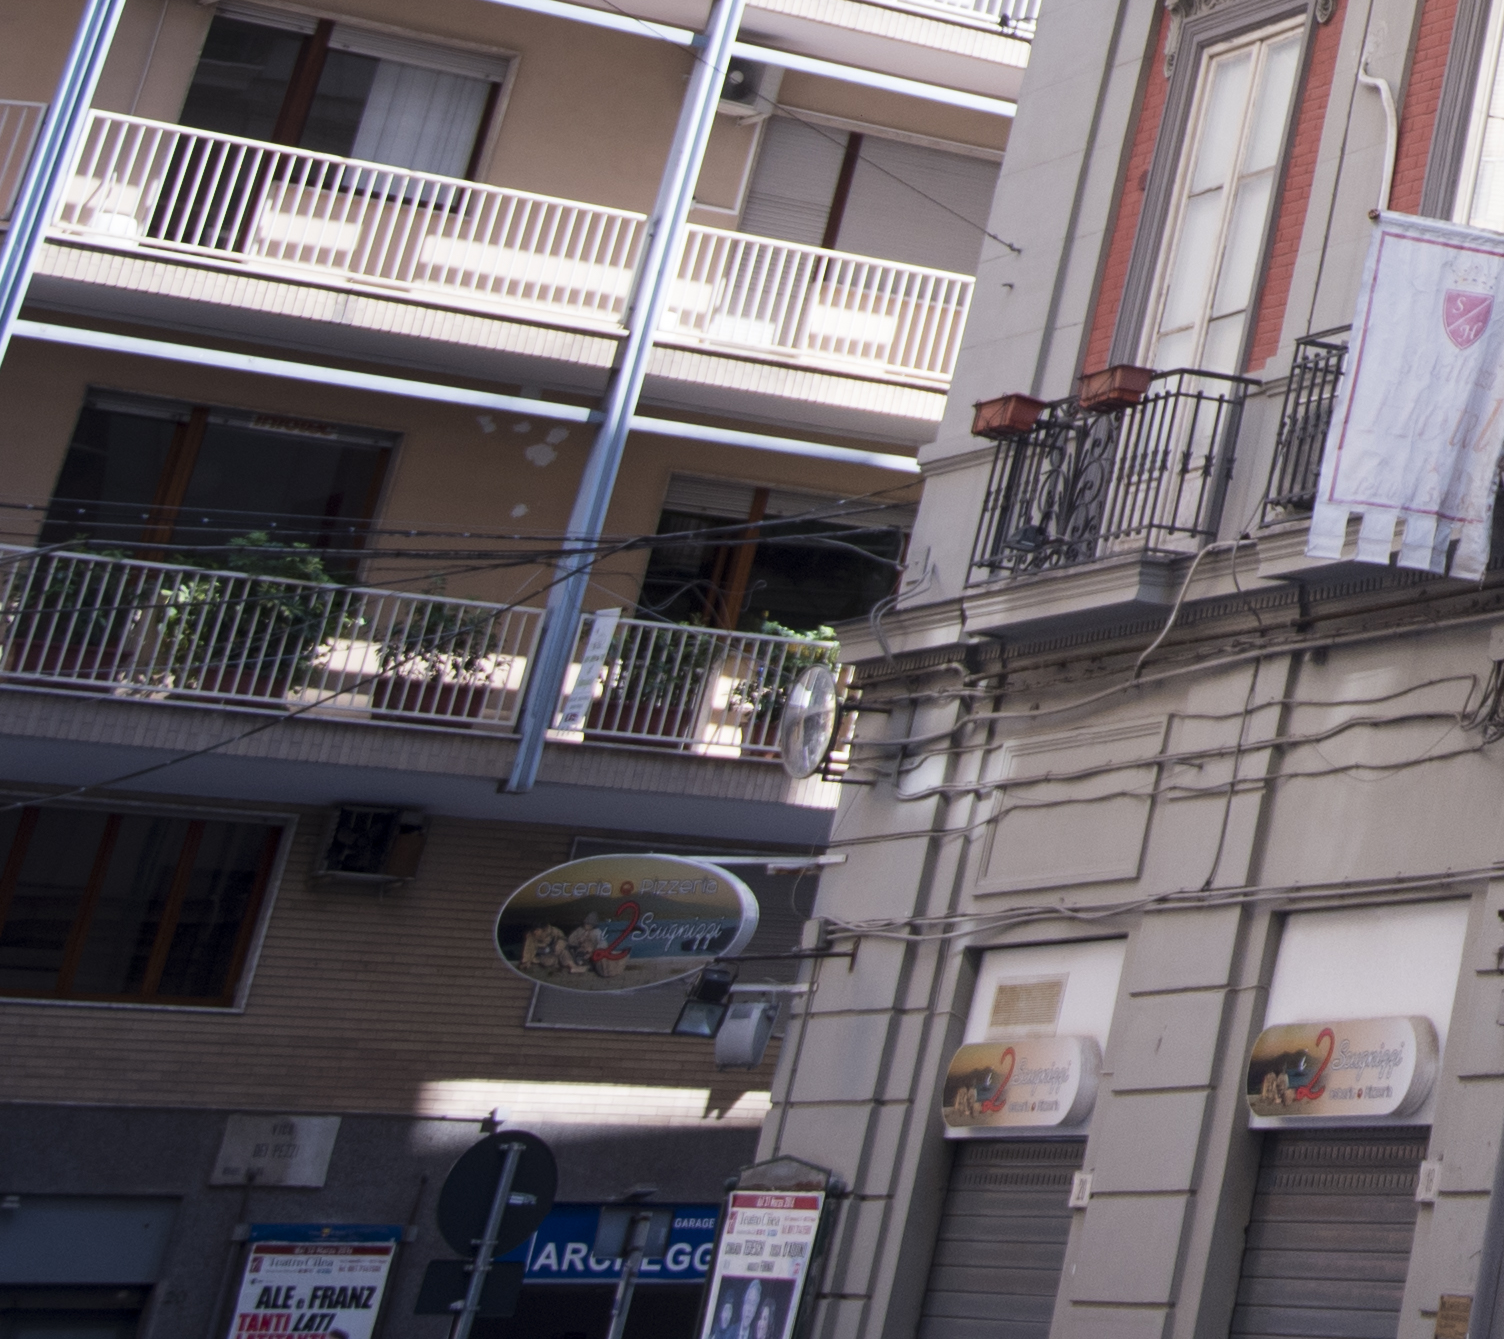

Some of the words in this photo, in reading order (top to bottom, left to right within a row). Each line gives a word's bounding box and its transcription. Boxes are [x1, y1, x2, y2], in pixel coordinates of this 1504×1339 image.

[1453, 297, 1465, 313] S
[536, 880, 612, 898] Osteria
[640, 877, 718, 896] Pizzeria
[592, 900, 641, 962] 2
[631, 912, 726, 952] Scugnizzi
[1295, 1027, 1335, 1101] 2
[1331, 1039, 1405, 1080] Scugnizzi
[981, 1047, 1016, 1114] 2
[674, 1217, 716, 1229] GARAGE
[255, 1285, 296, 1310] ALE
[308, 1285, 378, 1310] FRANZ
[237, 1312, 293, 1333] TANTI
[291, 1312, 337, 1333] LATI
